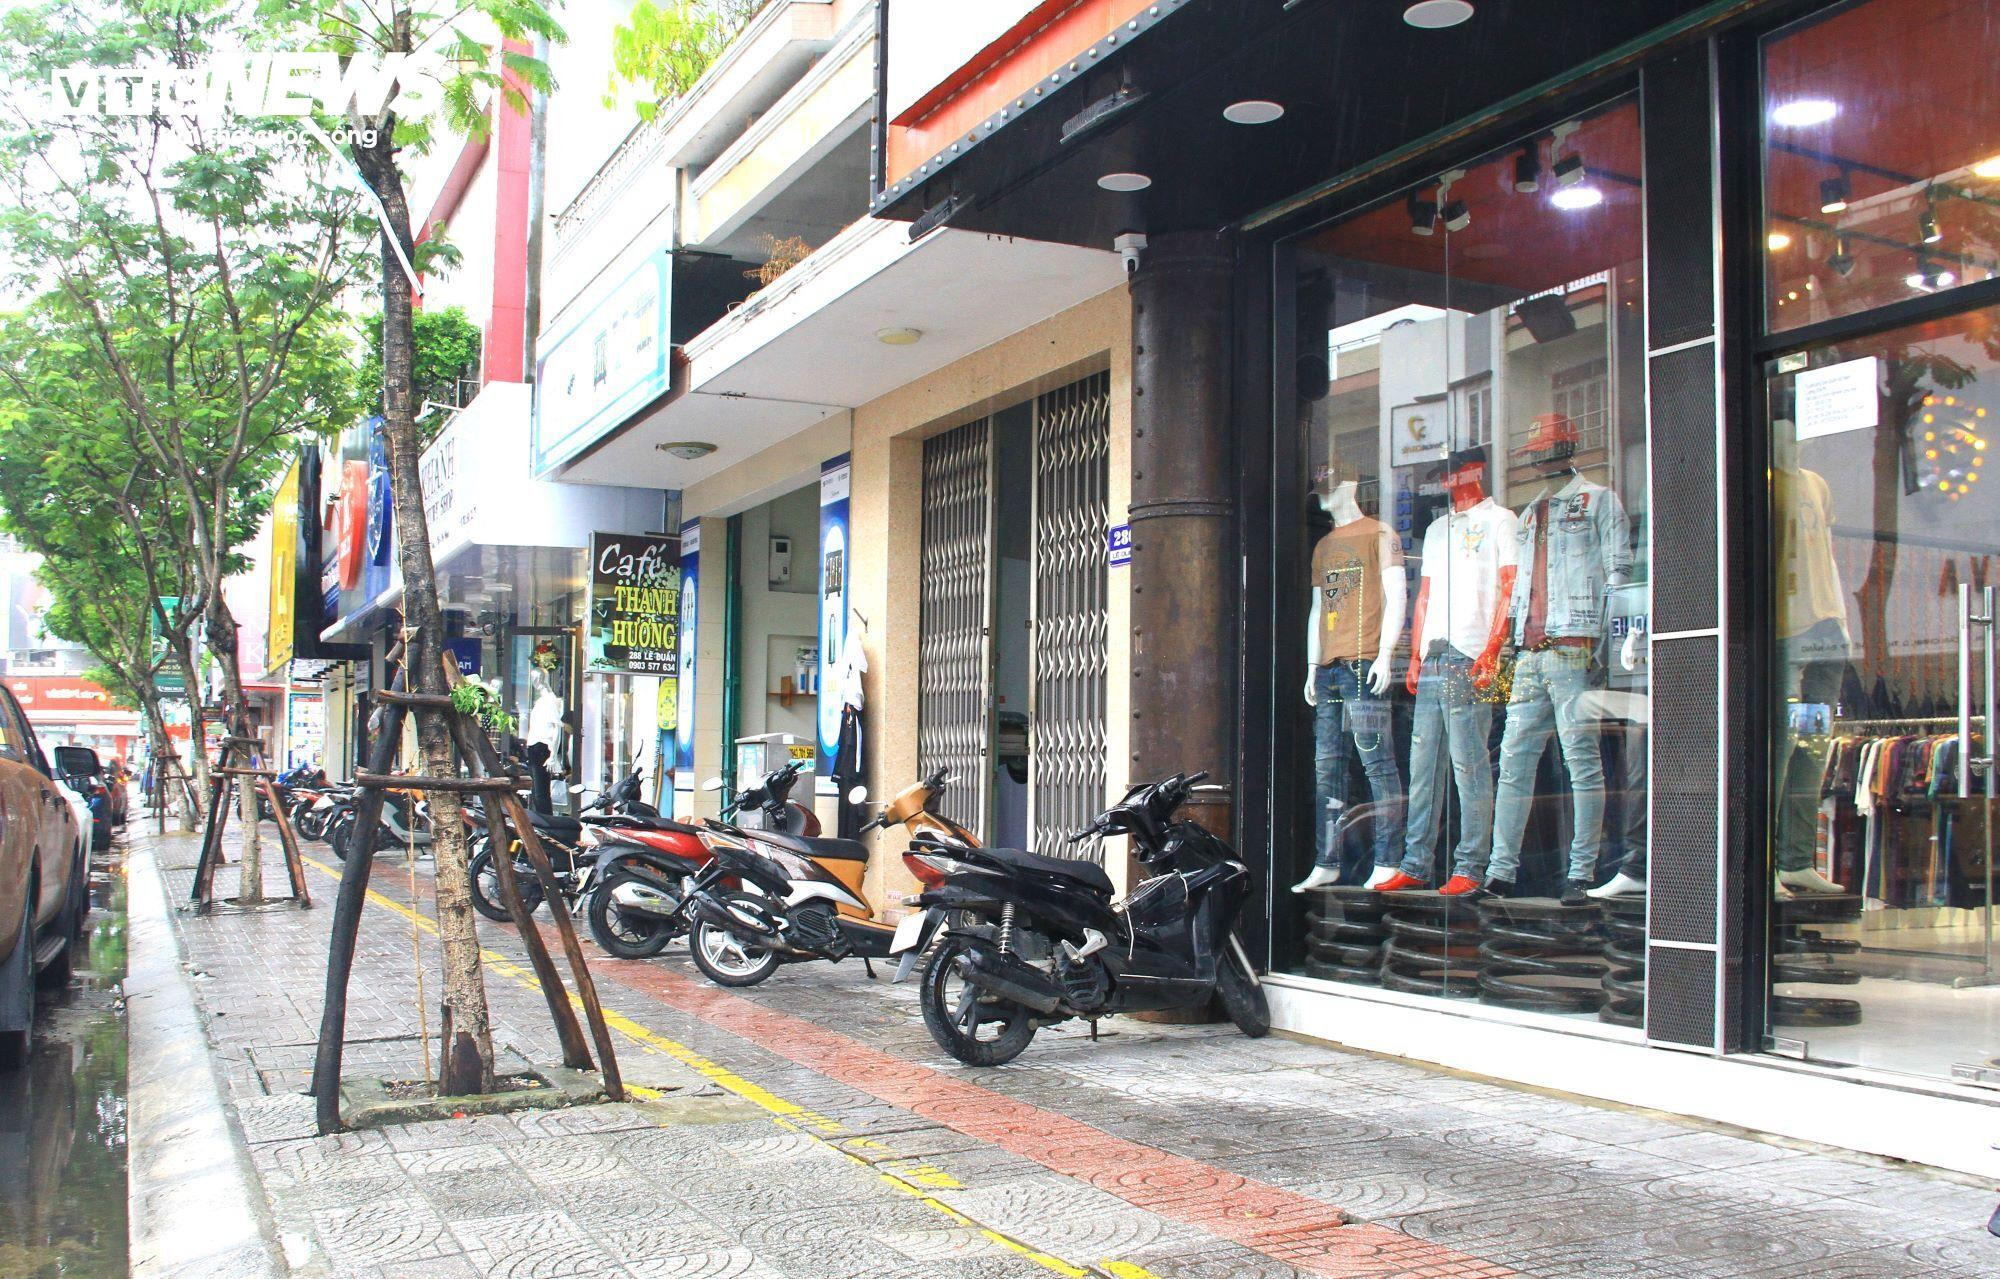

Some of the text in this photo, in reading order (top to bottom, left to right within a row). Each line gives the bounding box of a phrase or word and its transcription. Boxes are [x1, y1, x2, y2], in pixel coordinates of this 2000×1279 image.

[600, 543, 667, 587] Café
[614, 585, 678, 616] THANH
[612, 617, 677, 649] HƯƠNG
[629, 651, 642, 660] 288
[648, 662, 660, 670] 577
[663, 663, 675, 671] 634
